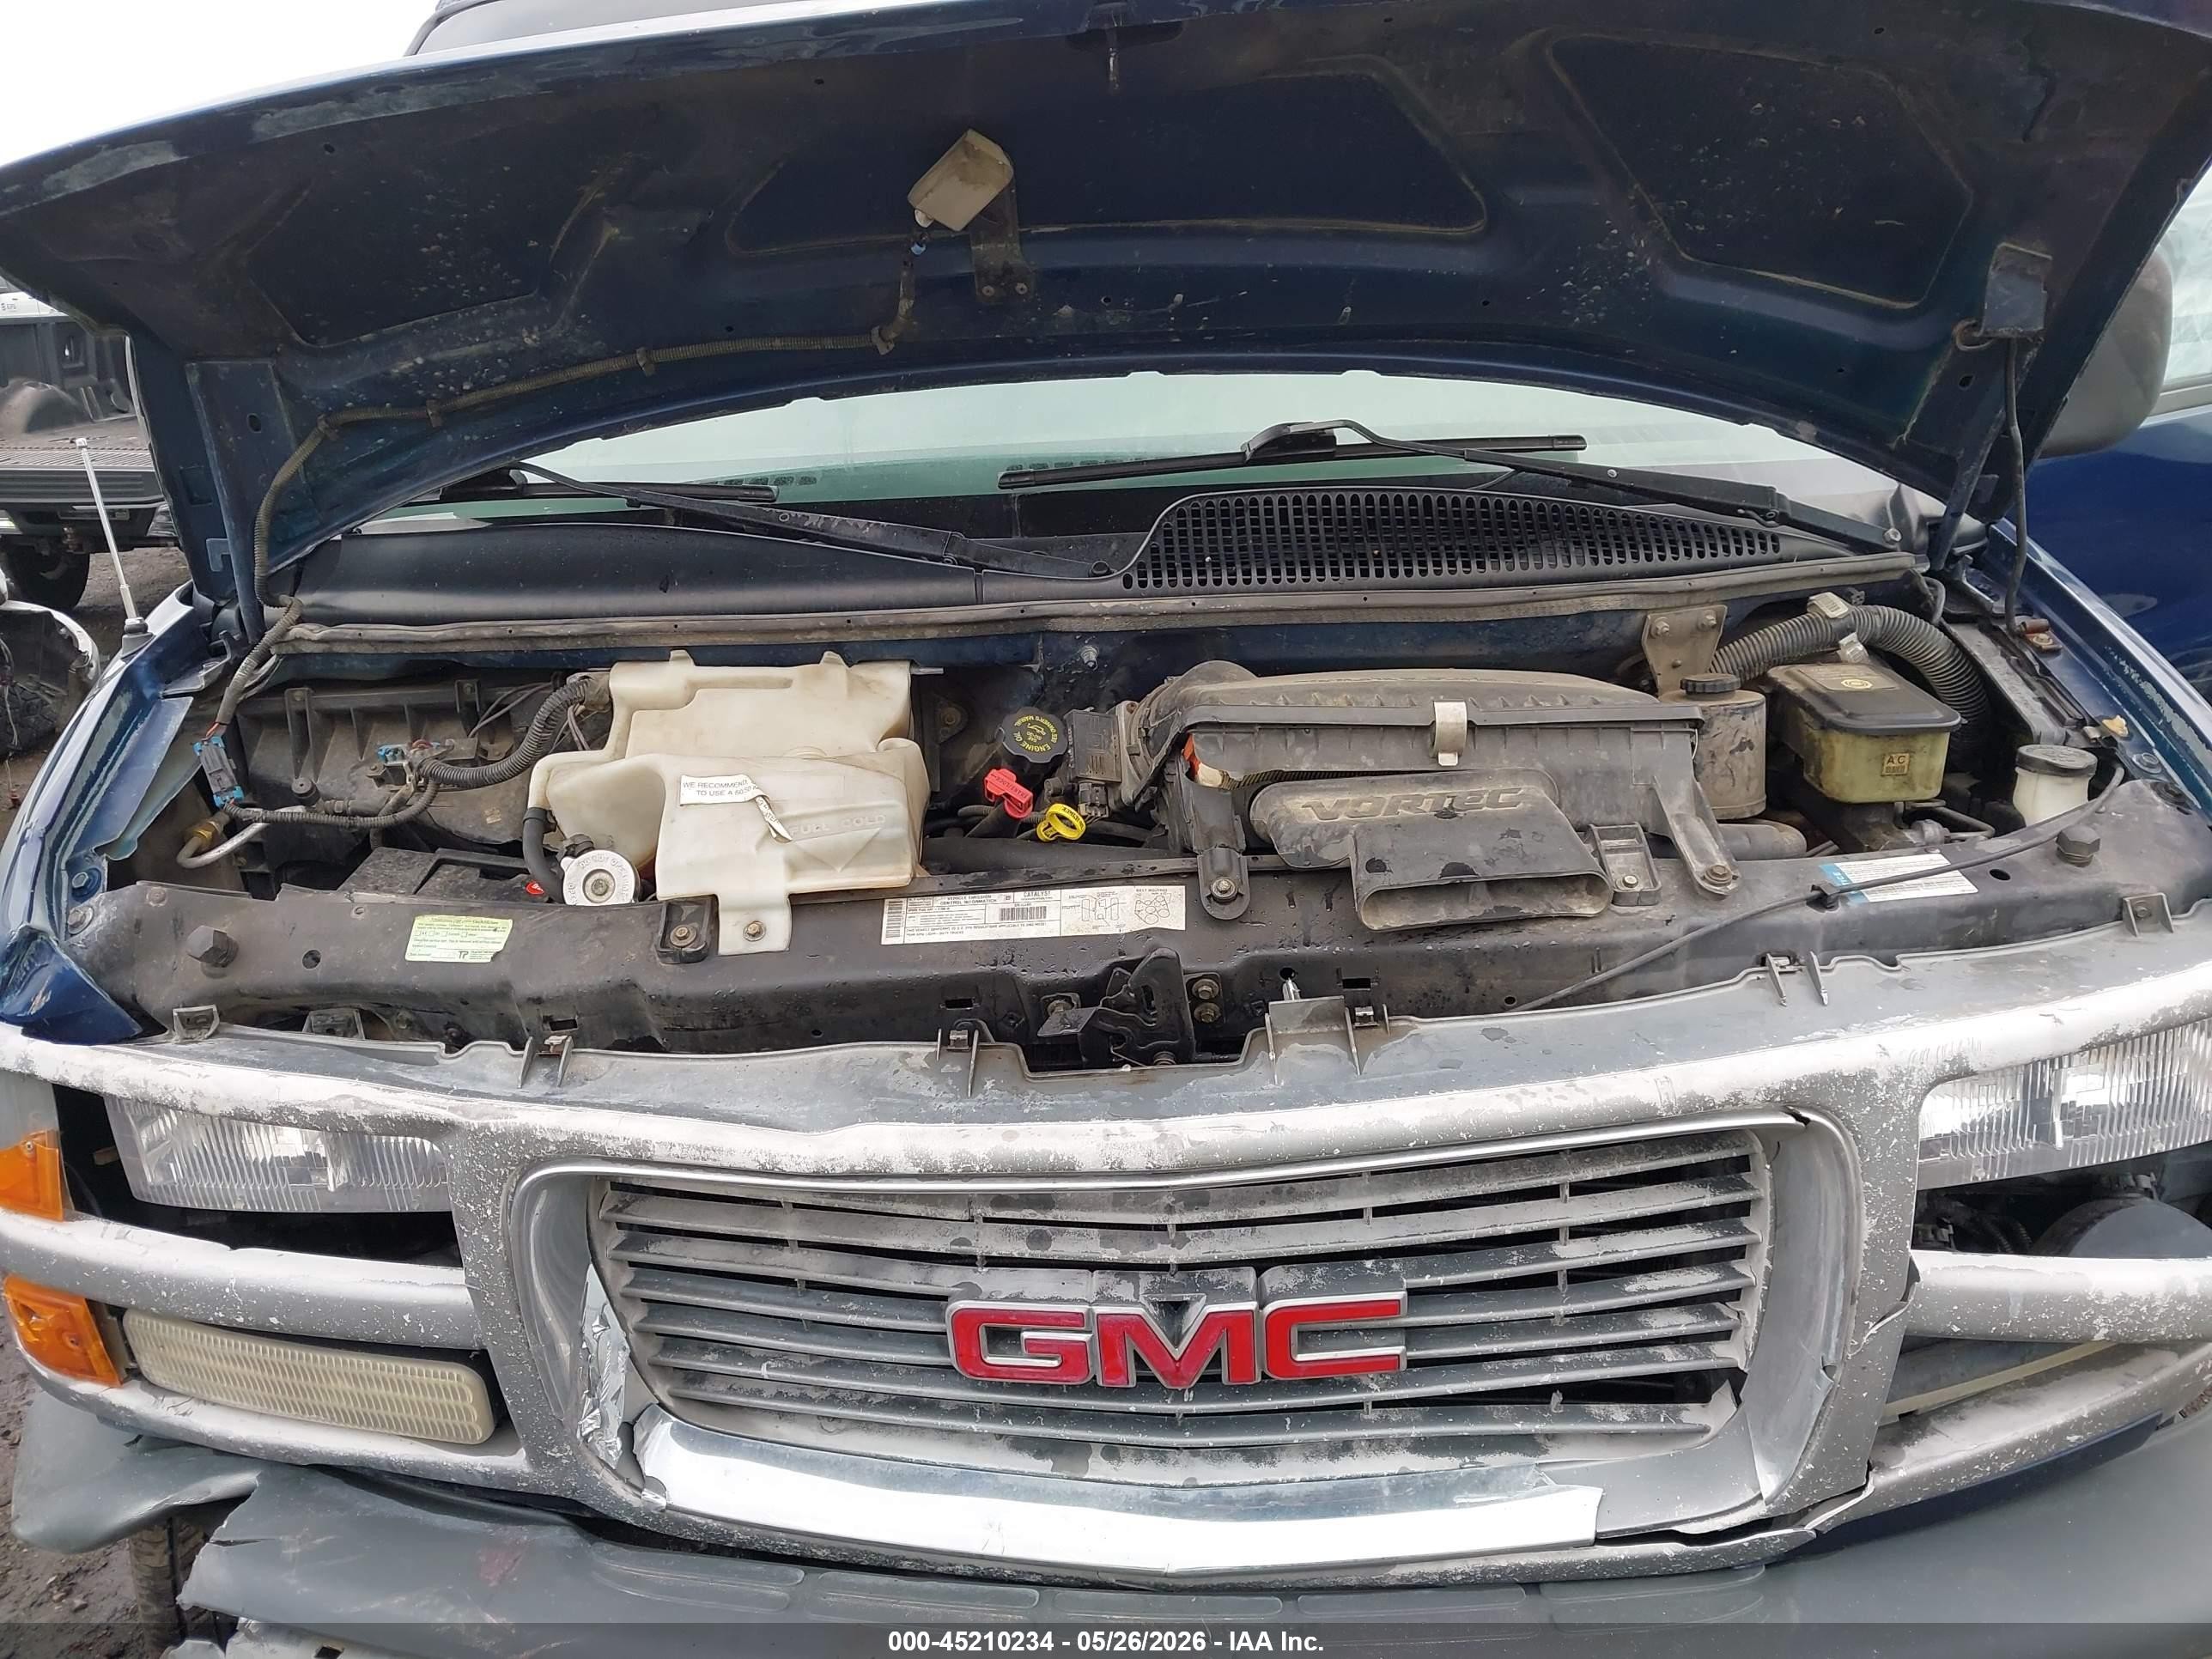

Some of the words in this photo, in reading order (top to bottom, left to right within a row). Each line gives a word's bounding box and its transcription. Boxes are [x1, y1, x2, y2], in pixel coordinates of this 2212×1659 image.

[1013, 731, 1023, 742] OIL
[1019, 740, 1052, 752] ENGINE
[1301, 787, 1526, 822] VORTEC
[947, 1291, 1408, 1389] GMC
